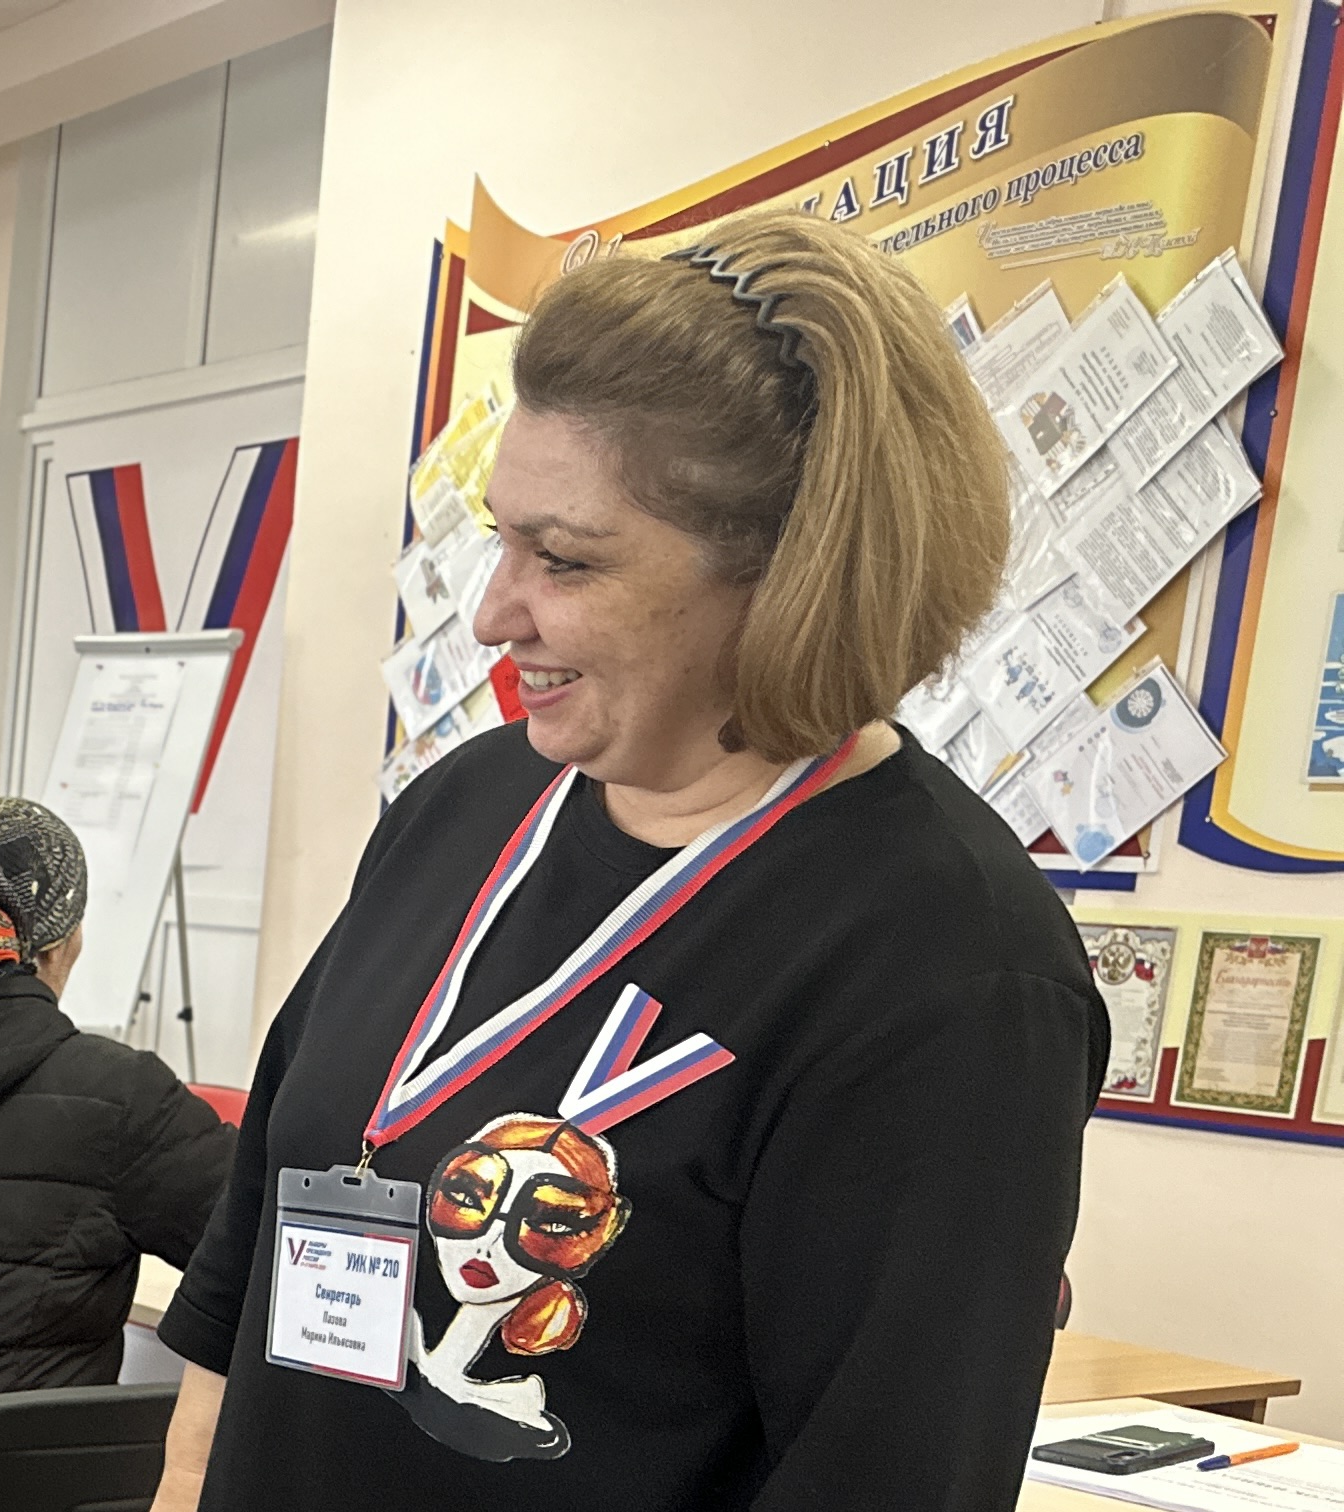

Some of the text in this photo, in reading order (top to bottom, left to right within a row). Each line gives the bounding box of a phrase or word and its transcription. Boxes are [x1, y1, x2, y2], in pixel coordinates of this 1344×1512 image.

[1005, 132, 1143, 206] процесса
[345, 1251, 367, 1274] УИК
[382, 1257, 400, 1279] 210
[315, 1283, 362, 1309] Секретарь
[300, 1326, 327, 1344] Марина
